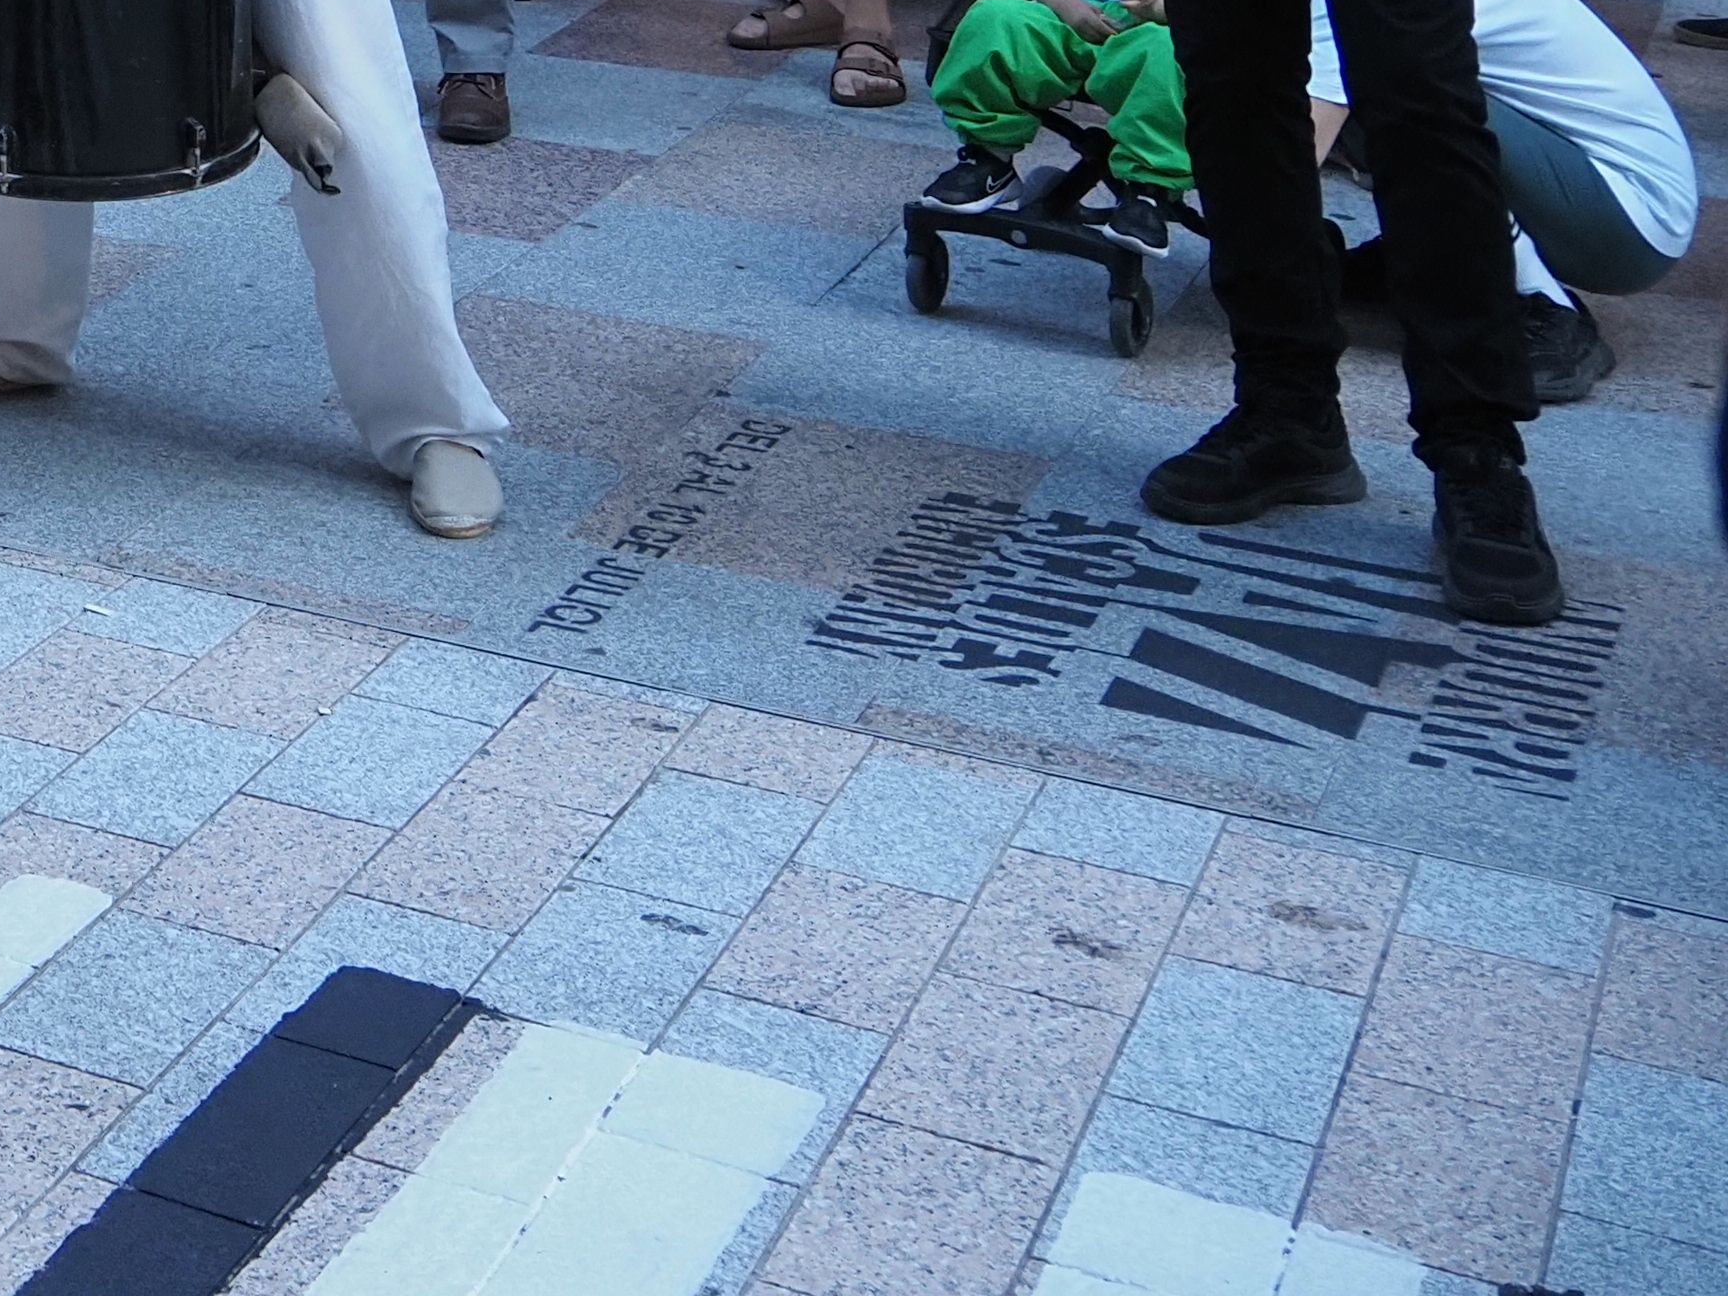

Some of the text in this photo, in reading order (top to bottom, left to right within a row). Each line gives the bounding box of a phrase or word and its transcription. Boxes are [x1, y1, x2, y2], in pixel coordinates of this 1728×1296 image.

[715, 419, 793, 453] DEL
[613, 524, 686, 559] DE
[527, 557, 645, 633] JULIOL
